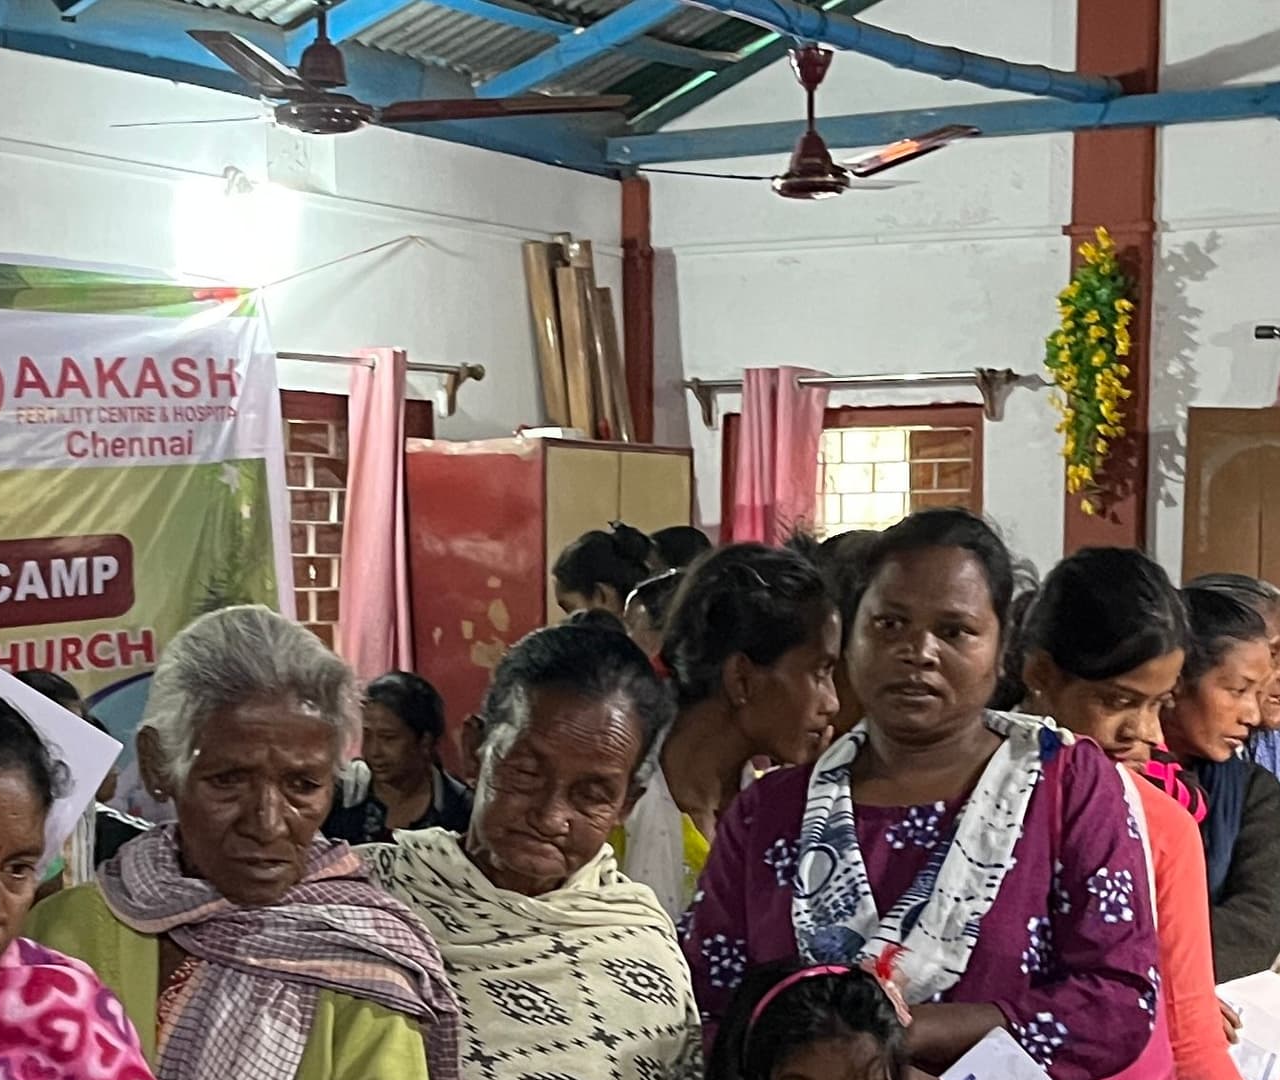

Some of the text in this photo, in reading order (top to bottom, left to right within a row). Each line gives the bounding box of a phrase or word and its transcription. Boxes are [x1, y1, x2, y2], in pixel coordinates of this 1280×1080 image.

[14, 355, 239, 399] AAKASH
[17, 404, 237, 425] FERTILITY CENTRE & HOSPITA
[66, 430, 193, 459] Chennai
